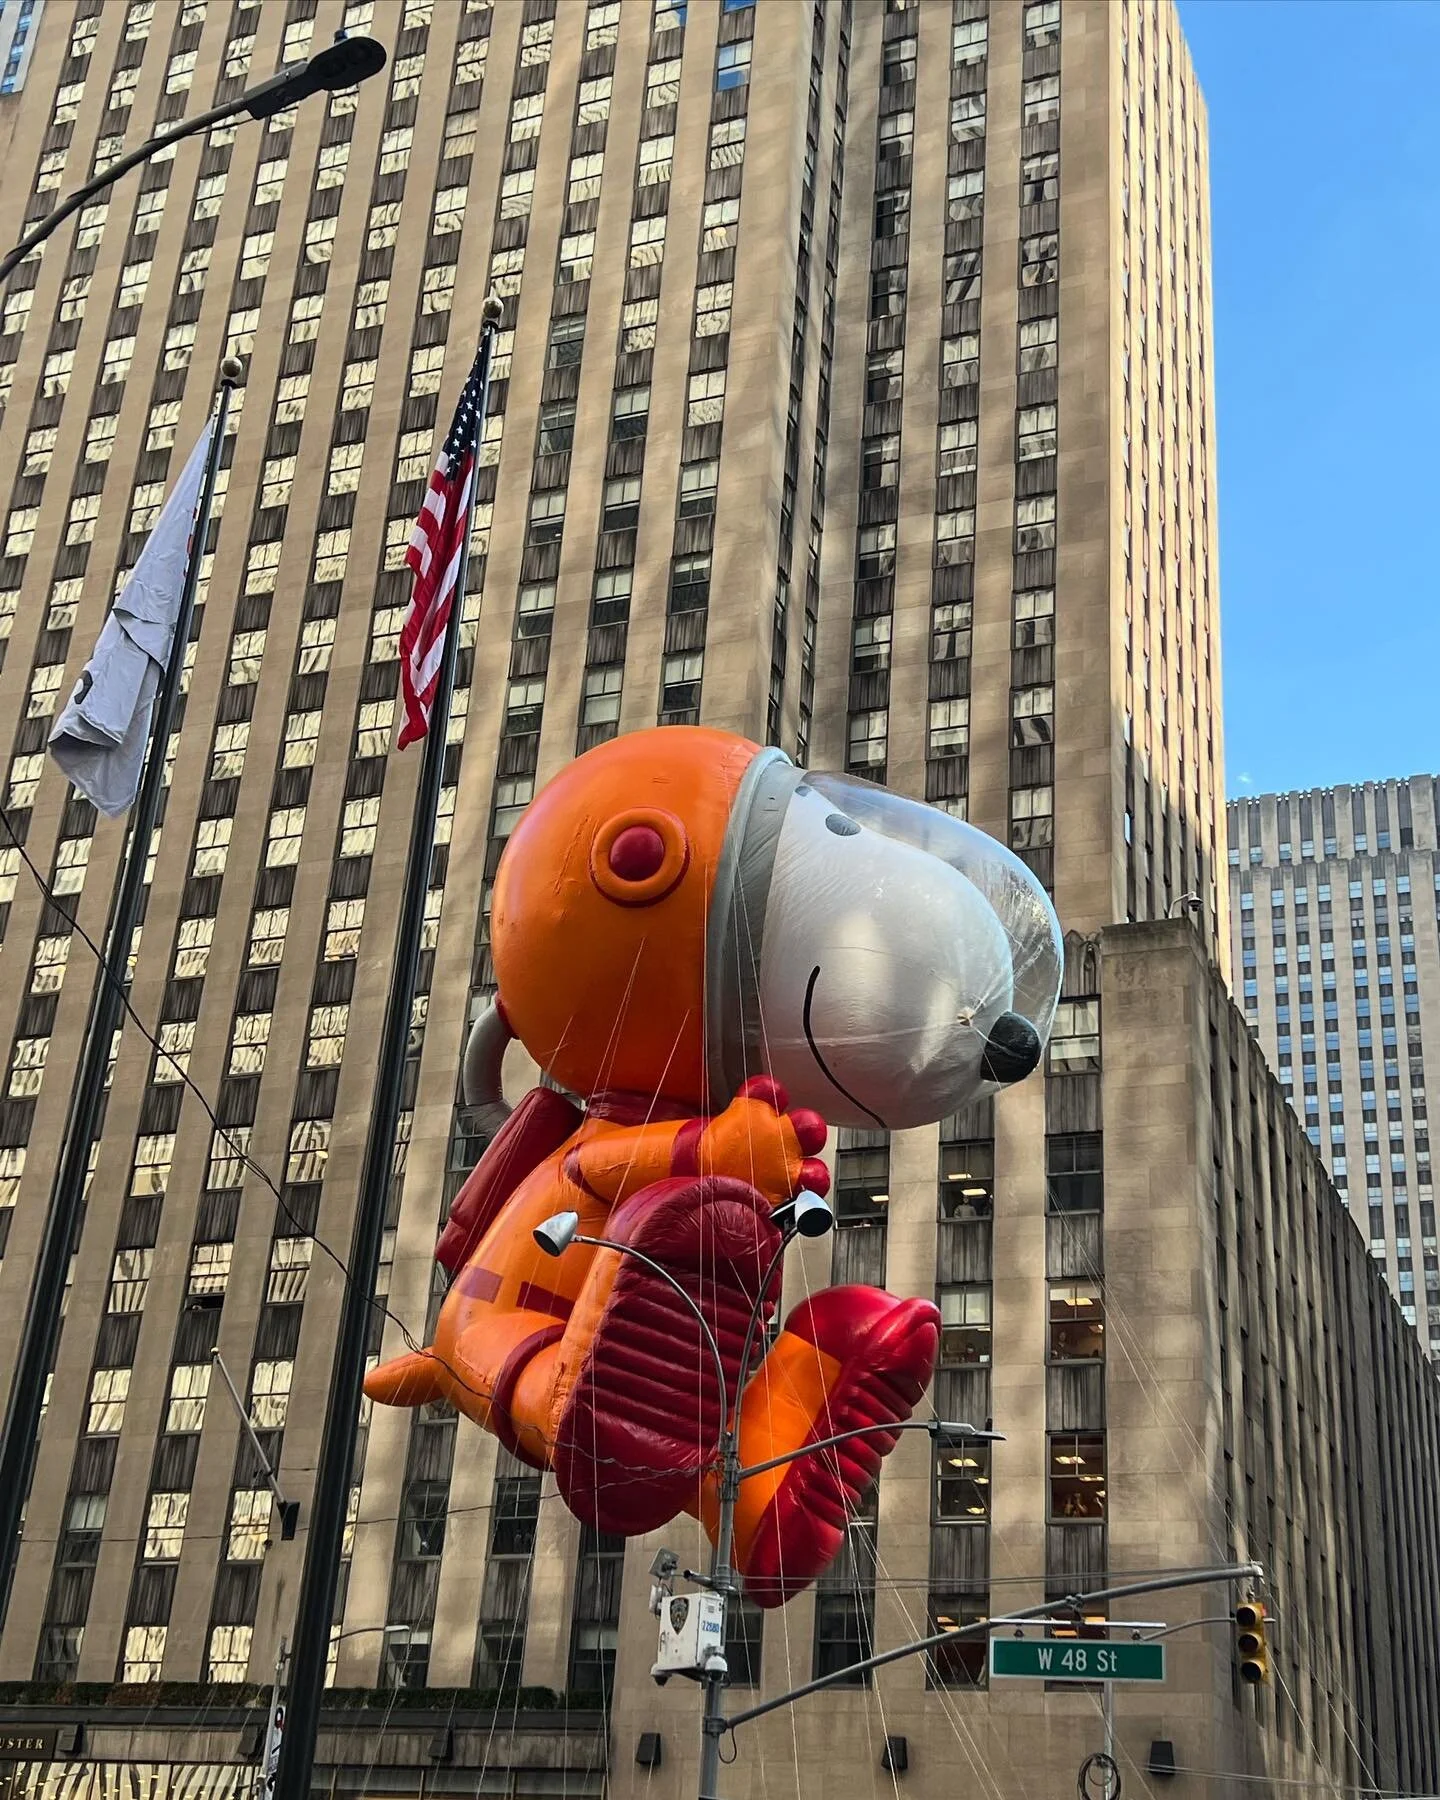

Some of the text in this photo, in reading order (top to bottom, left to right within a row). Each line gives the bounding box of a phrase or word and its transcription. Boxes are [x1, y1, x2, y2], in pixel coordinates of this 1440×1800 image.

[1037, 1647, 1117, 1673] W 48 St
